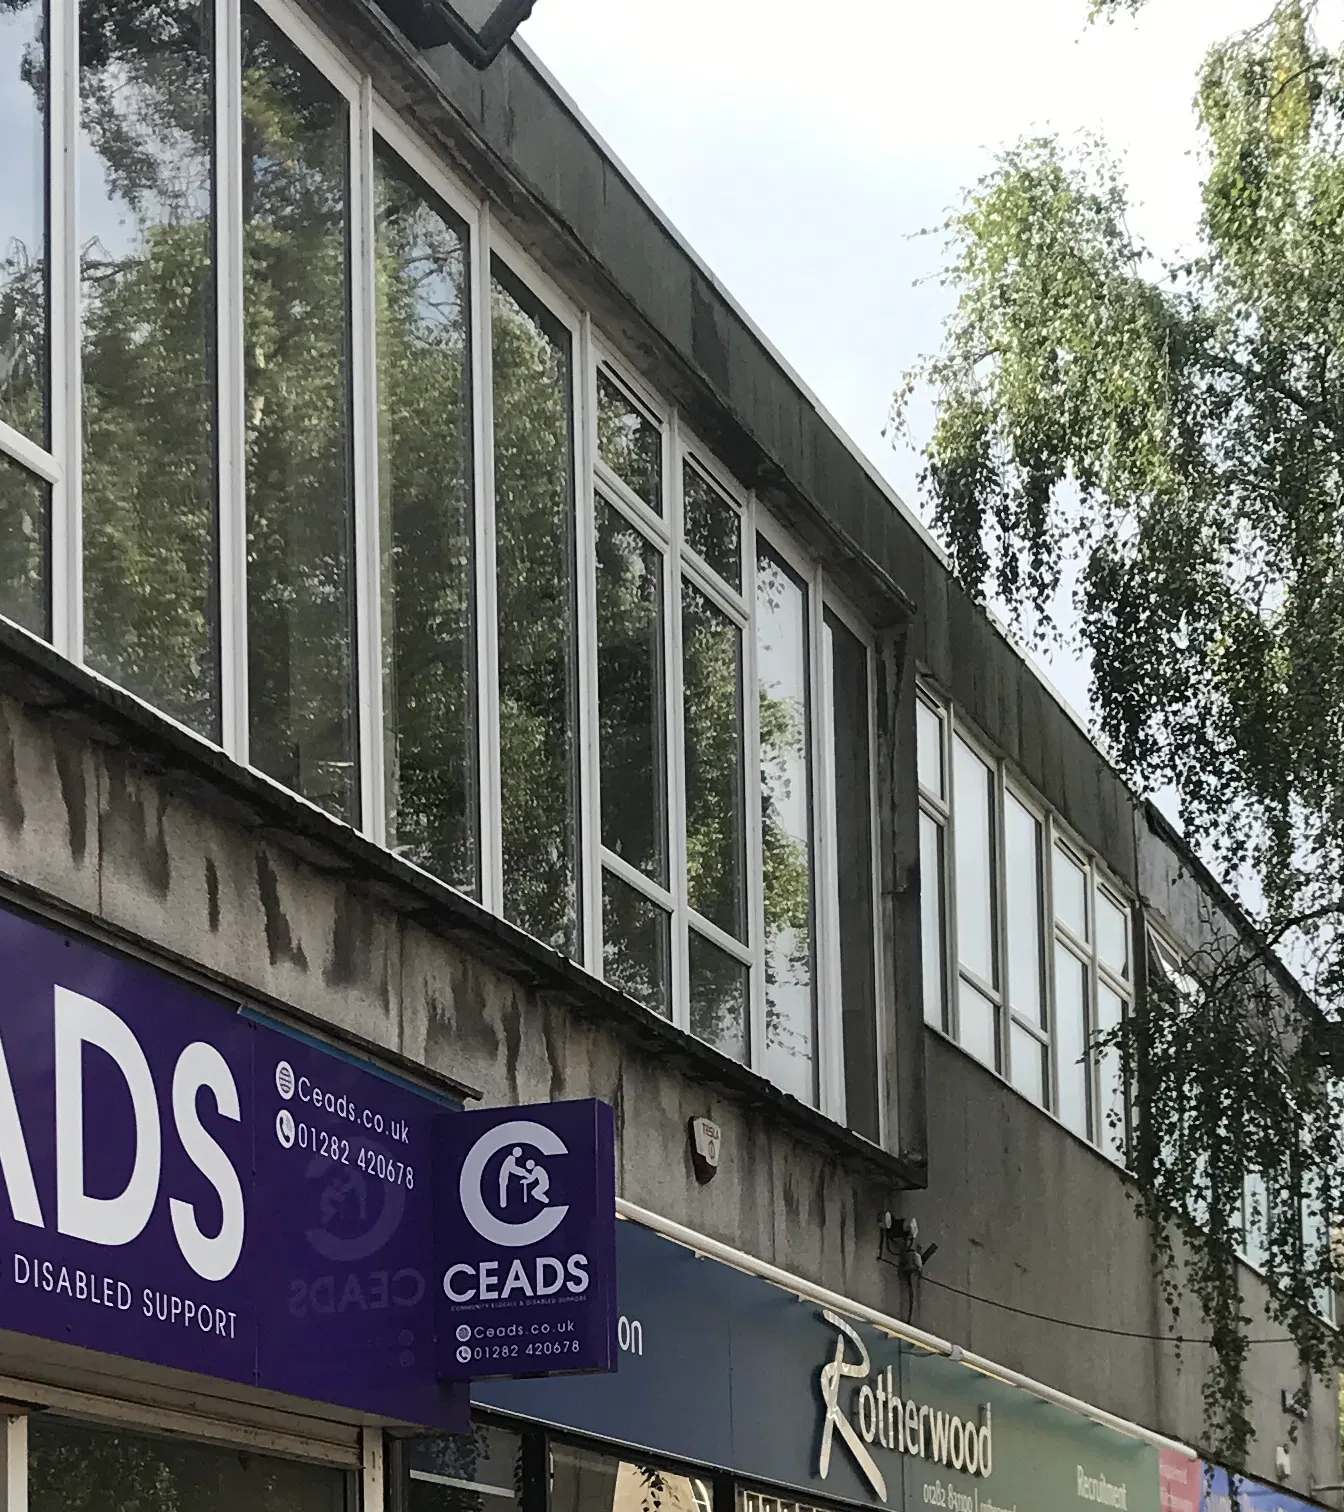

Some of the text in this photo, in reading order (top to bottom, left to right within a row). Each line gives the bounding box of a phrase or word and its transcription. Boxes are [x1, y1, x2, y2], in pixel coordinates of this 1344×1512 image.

[298, 1076, 409, 1144] Ceads.co.uk
[298, 1123, 414, 1190] 01282 420678
[14, 1253, 132, 1310] DISABLED
[142, 1288, 237, 1339] SUPPORT
[443, 1253, 590, 1302] CEADS
[473, 1320, 575, 1339] Ceads.co.uk
[473, 1340, 580, 1360] 01282 420678
[819, 1309, 992, 1503] Rotherwood
[922, 1480, 946, 1508] 01282
[1076, 1464, 1128, 1512] Recruitment
